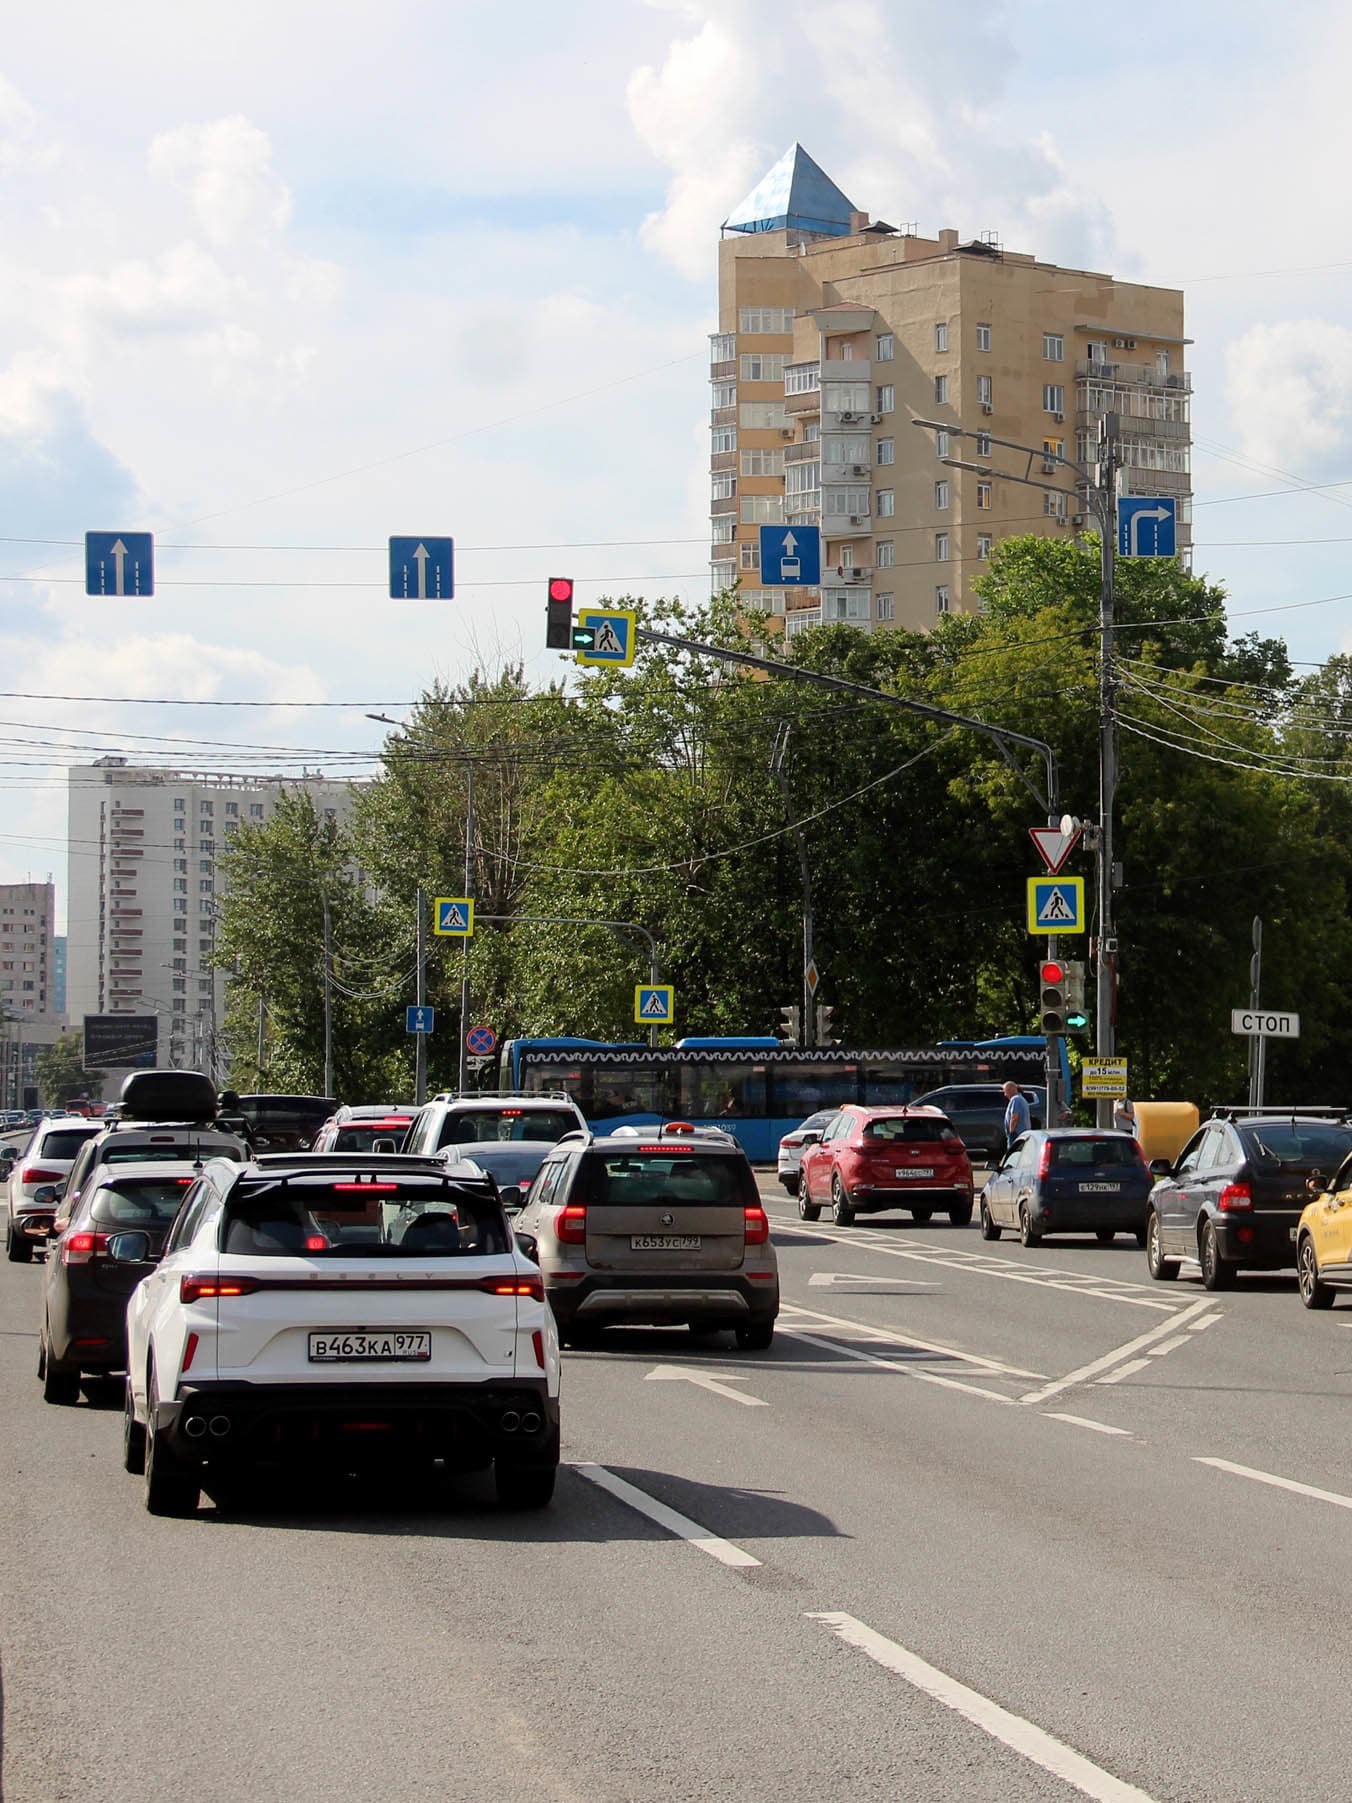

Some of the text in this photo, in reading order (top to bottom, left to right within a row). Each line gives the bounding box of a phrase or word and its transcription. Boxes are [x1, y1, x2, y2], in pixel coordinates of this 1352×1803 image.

[1242, 1015, 1290, 1032] СТОП
[1088, 1058, 1123, 1066] КРЕДИТ
[1097, 1067, 1107, 1075] 15
[635, 1236, 679, 1248] К653УС
[316, 1336, 424, 1355] В463КА 977
